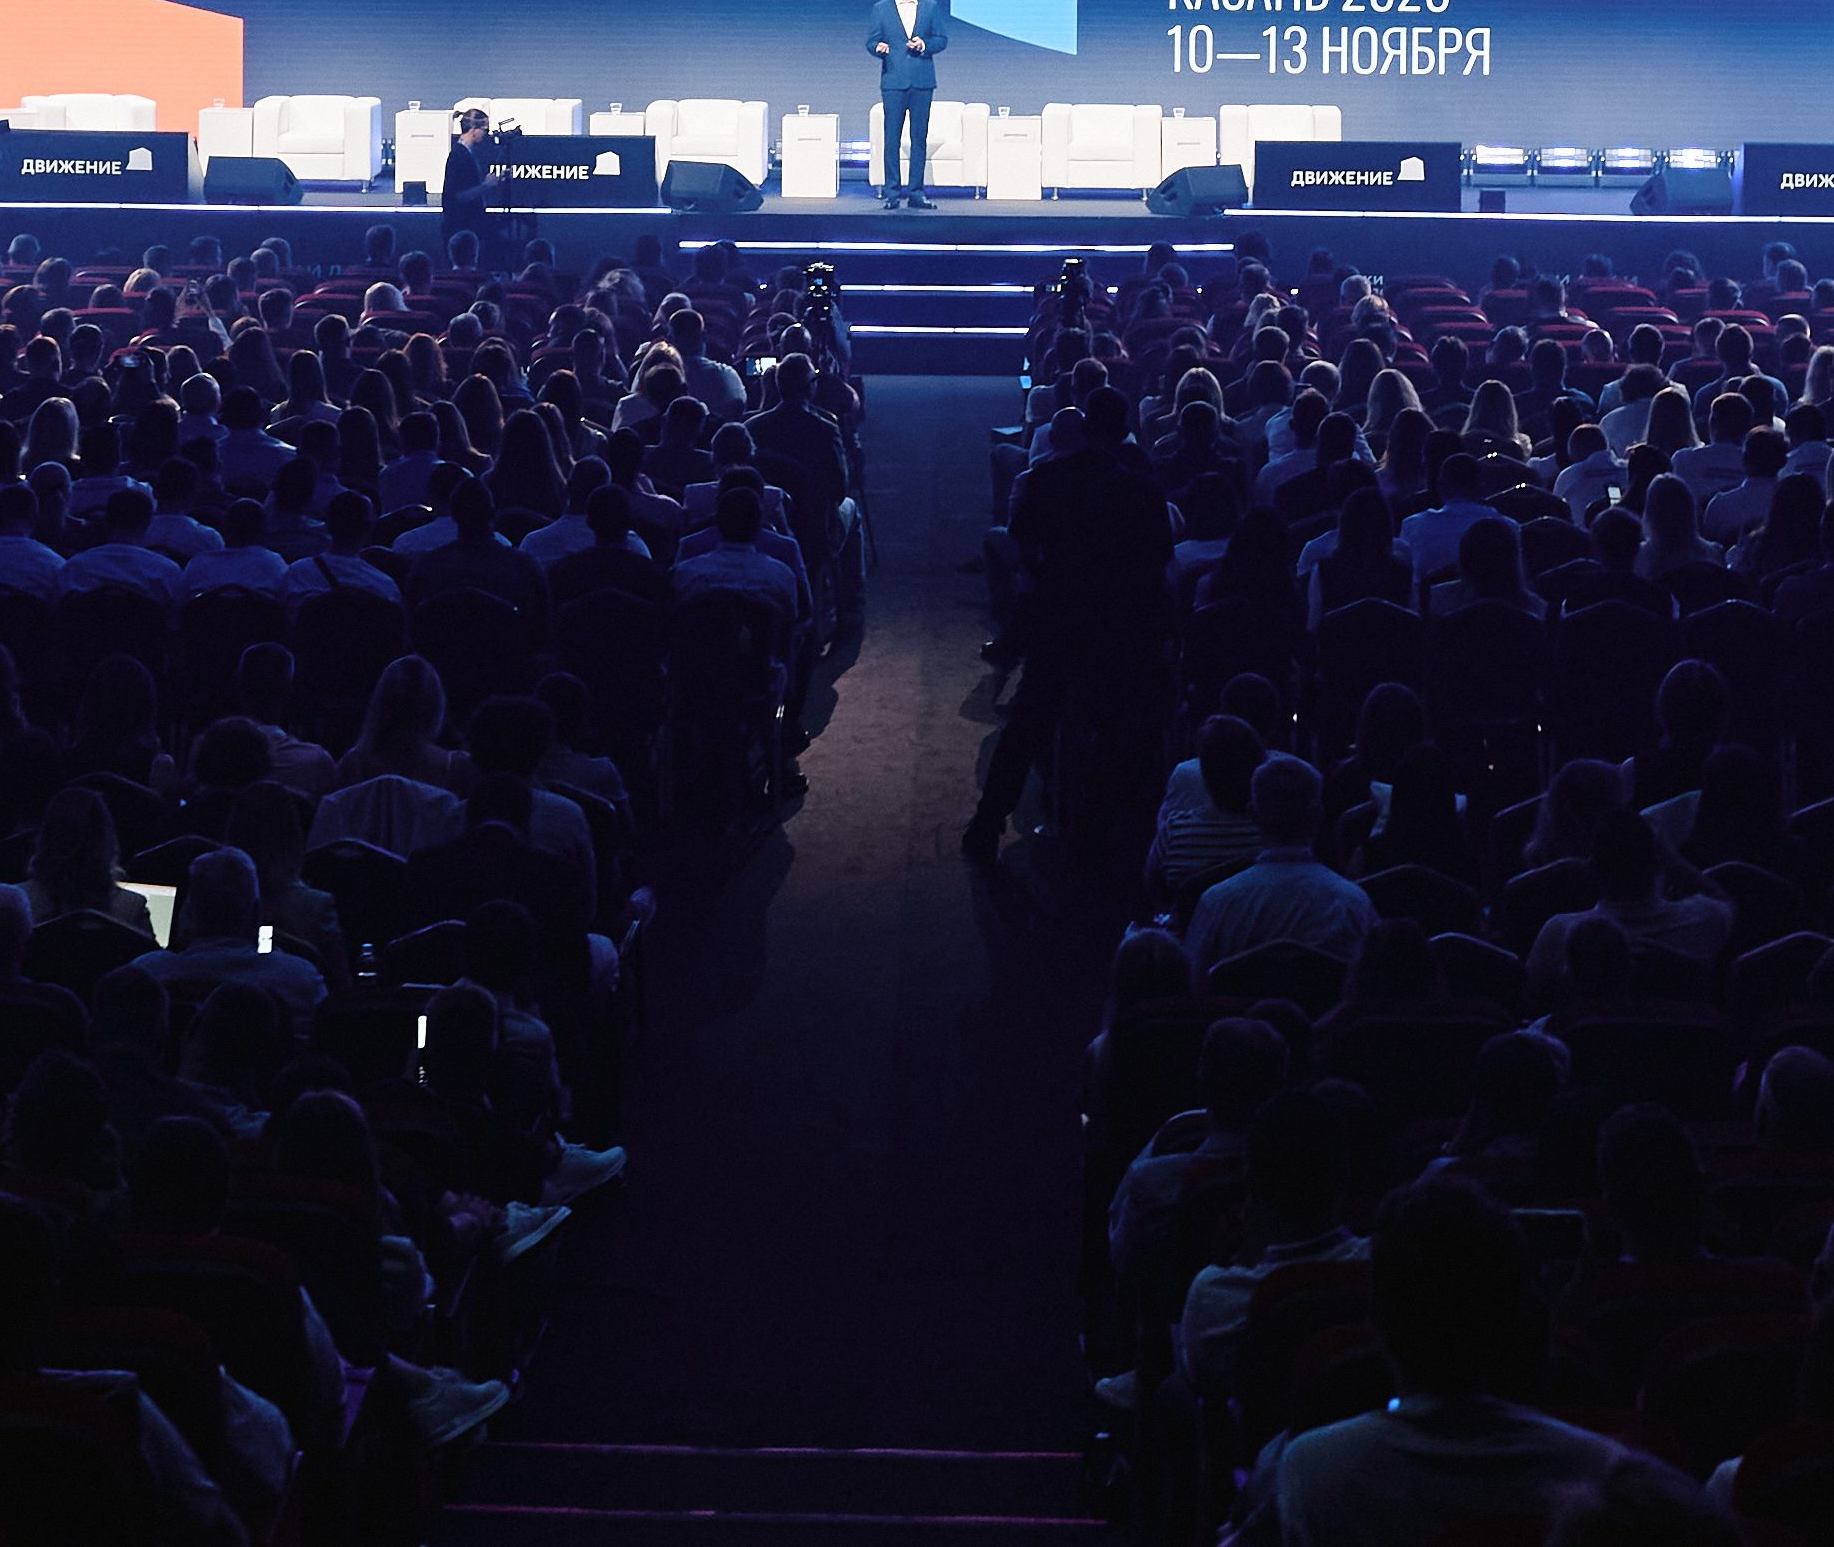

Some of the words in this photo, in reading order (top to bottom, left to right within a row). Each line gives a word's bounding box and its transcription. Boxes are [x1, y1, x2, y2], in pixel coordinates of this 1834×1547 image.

[1321, 26, 1491, 76] НОЯБРЯ
[21, 158, 122, 175] ДВИЖЕНИЕ
[489, 164, 590, 180] ИЖЕНИЕ
[1290, 170, 1393, 187] ДВИЖЕНИЕ
